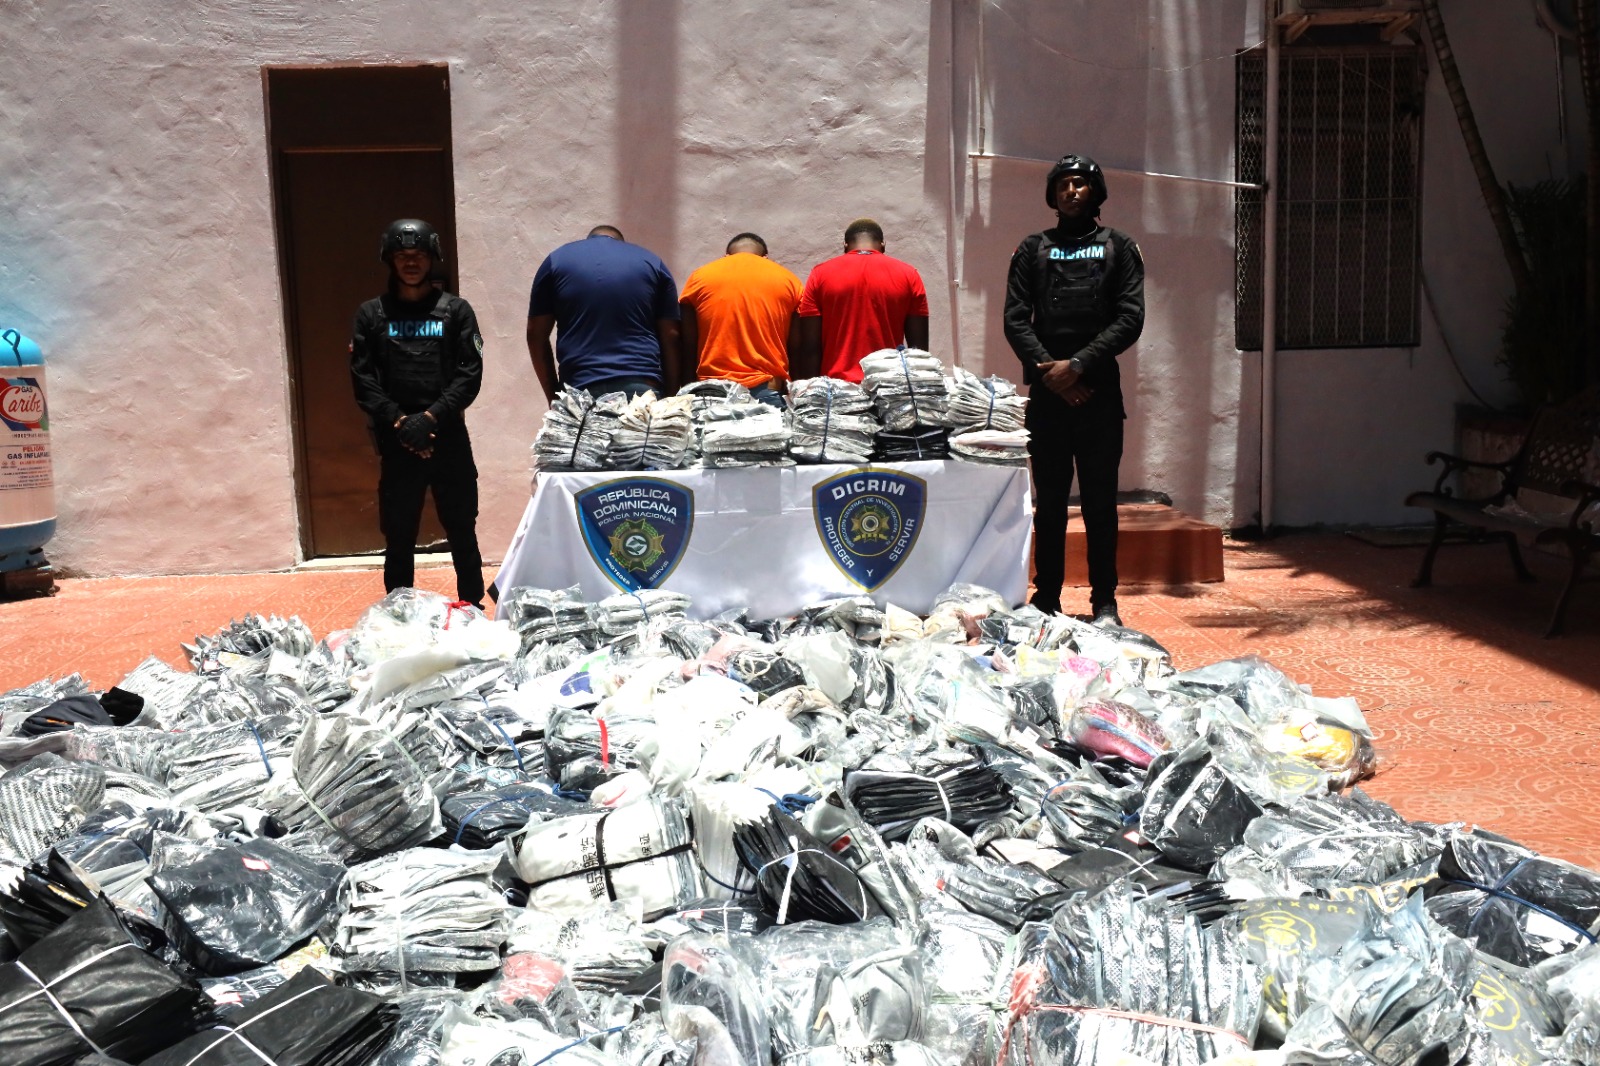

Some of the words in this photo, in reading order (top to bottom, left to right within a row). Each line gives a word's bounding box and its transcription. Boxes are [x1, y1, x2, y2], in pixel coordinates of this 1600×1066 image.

[388, 321, 443, 336] DICRIM
[0, 386, 43, 423] Caribe
[598, 487, 670, 504] REPÚBLICA
[832, 479, 906, 500] DICRIM
[593, 500, 677, 519] DOMINICANA
[633, 511, 676, 525] NACIONAL
[824, 516, 855, 569] PROTEGER
[866, 569, 874, 577] Y
[889, 518, 915, 562] SERVIR
[605, 558, 630, 585] PROTEGER
[648, 561, 669, 582] SERVIR
